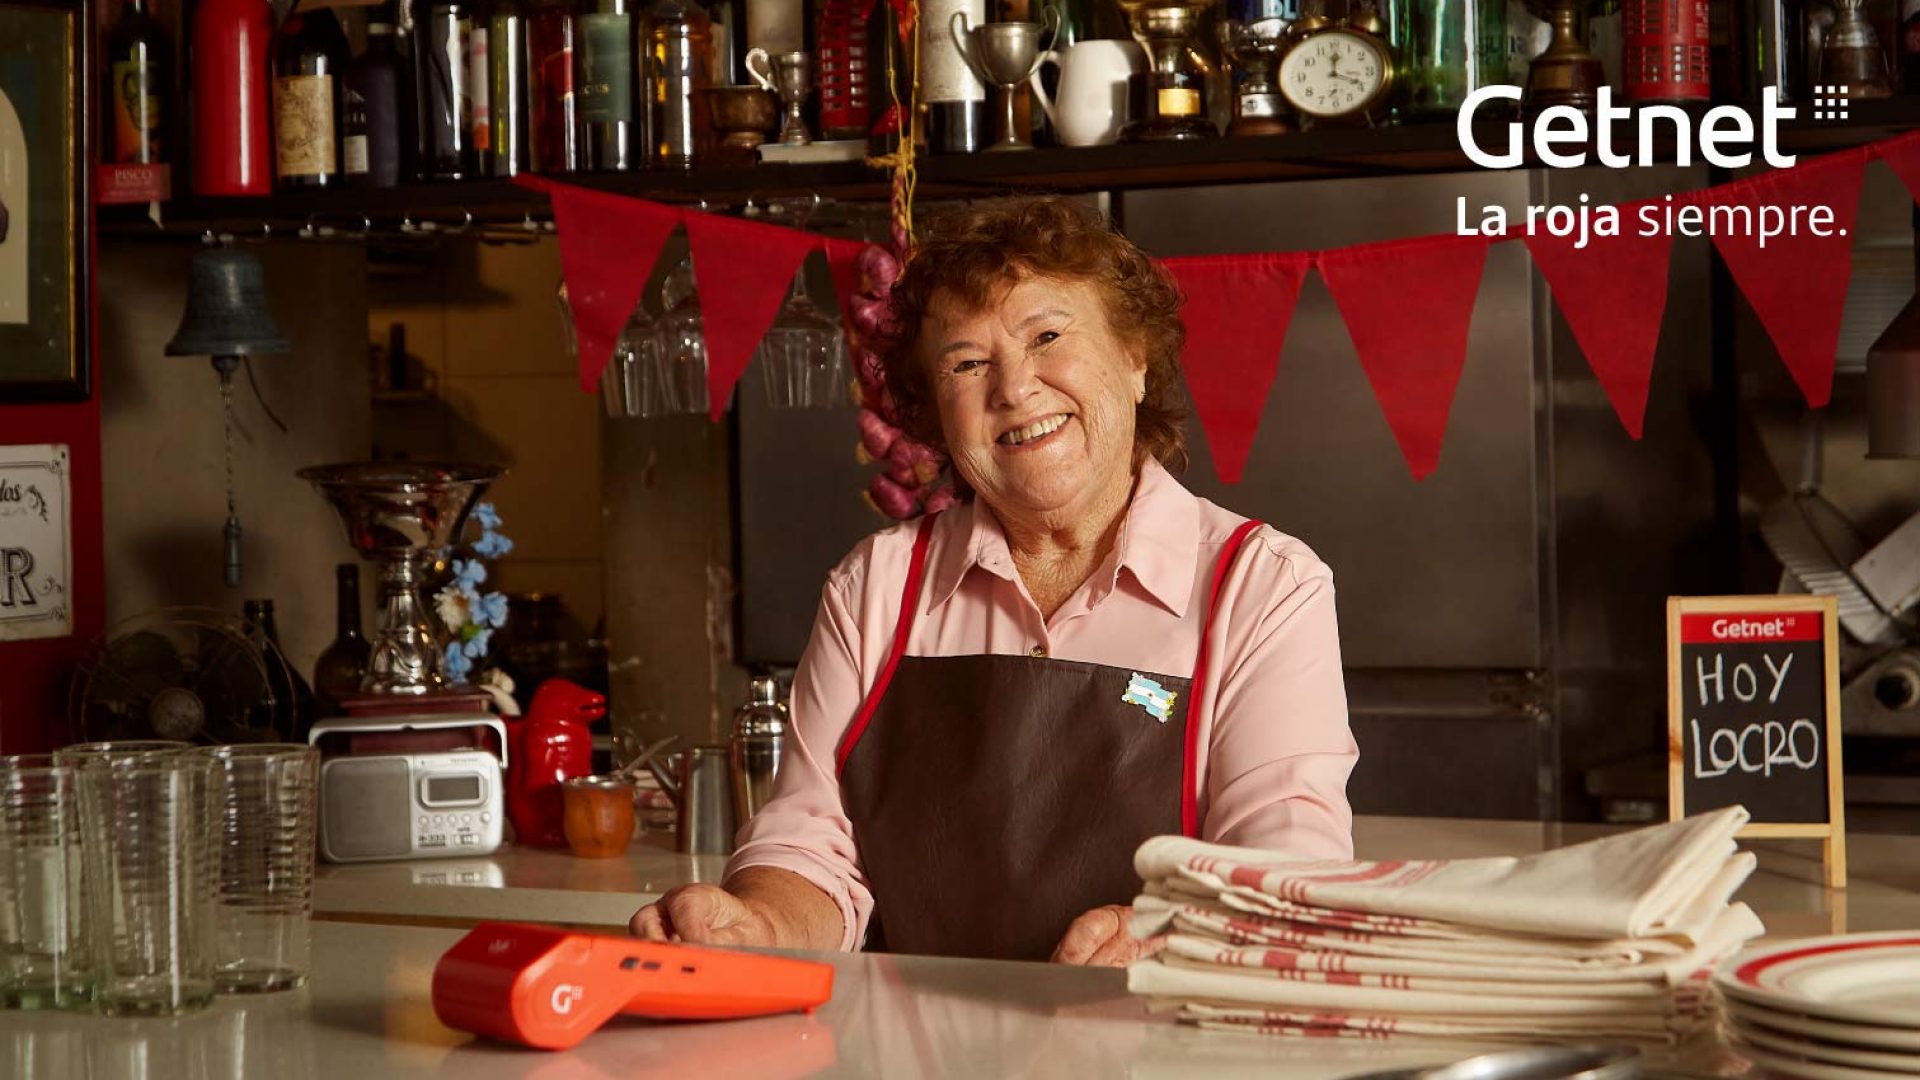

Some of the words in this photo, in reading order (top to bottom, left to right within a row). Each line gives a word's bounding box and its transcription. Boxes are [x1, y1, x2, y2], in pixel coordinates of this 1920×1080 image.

[1712, 618, 1784, 638] Getnet
[1697, 653, 1793, 706] HOY
[1691, 719, 1818, 778] LOCRO
[552, 984, 571, 1014] G
